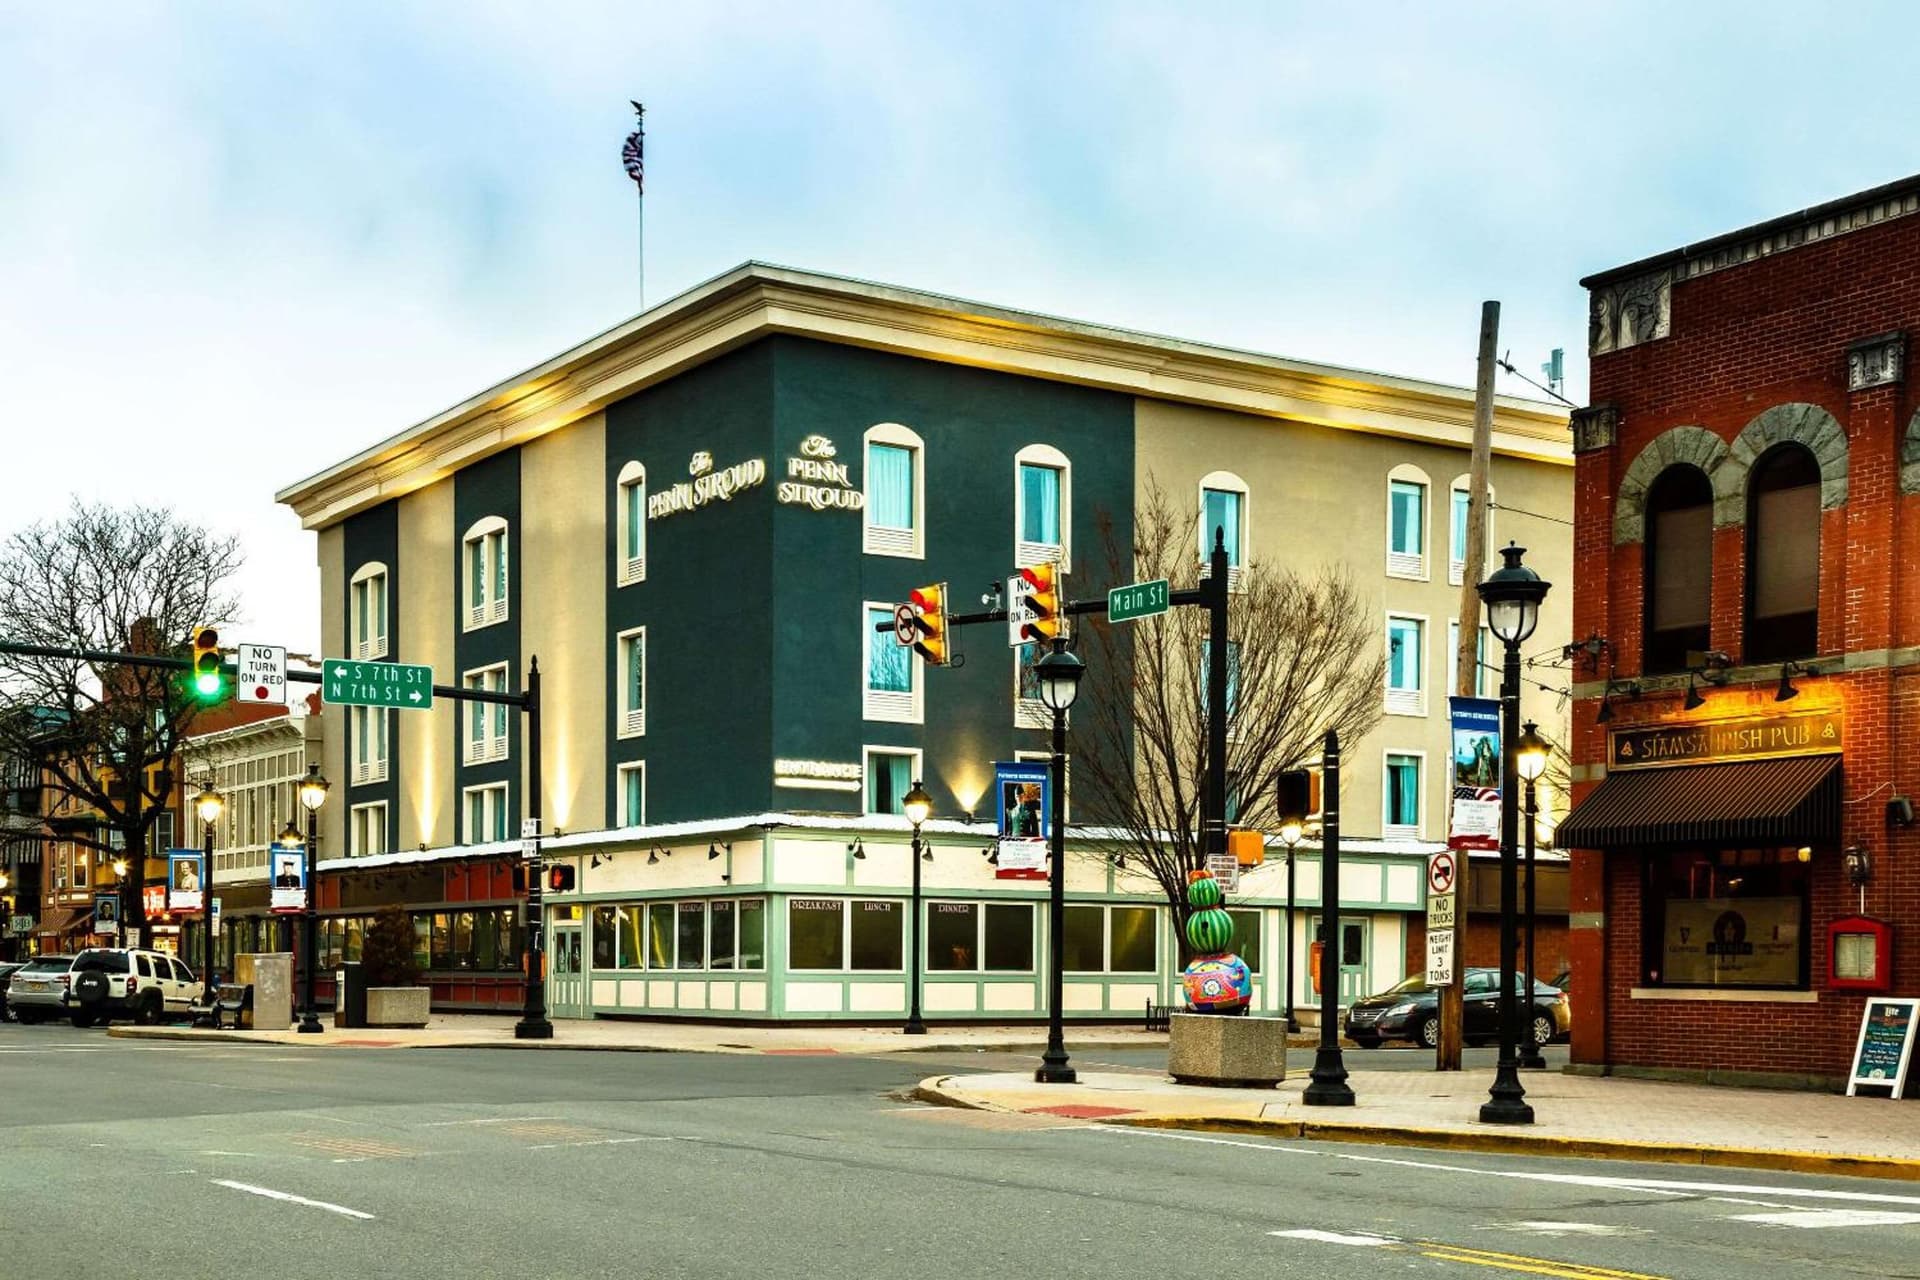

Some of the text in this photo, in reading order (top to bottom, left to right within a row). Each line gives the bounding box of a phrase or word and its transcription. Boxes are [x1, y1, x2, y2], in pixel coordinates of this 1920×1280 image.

[788, 458, 853, 487] PENN
[648, 458, 766, 519] PENN STROUD
[778, 482, 864, 511] STROUD
[1113, 585, 1164, 612] Main St
[1011, 611, 1021, 623] ON
[252, 648, 272, 660] NO
[249, 661, 277, 672] TURN
[241, 673, 284, 685] ON RED
[354, 665, 423, 684] S 7th St
[332, 684, 401, 701] N 7th St
[1716, 729, 1763, 751] IRISH
[1771, 724, 1810, 747] PUB
[791, 900, 969, 913] BREAKFAST LUNCH DINNER
[1435, 899, 1449, 912] NO
[1429, 912, 1454, 924] TRUCKS
[1429, 933, 1452, 944] WEIGHT
[1431, 945, 1449, 955] LIMIT
[1436, 957, 1444, 968] 3
[1429, 970, 1450, 981] TONS
[1884, 1006, 1900, 1017] Lite
